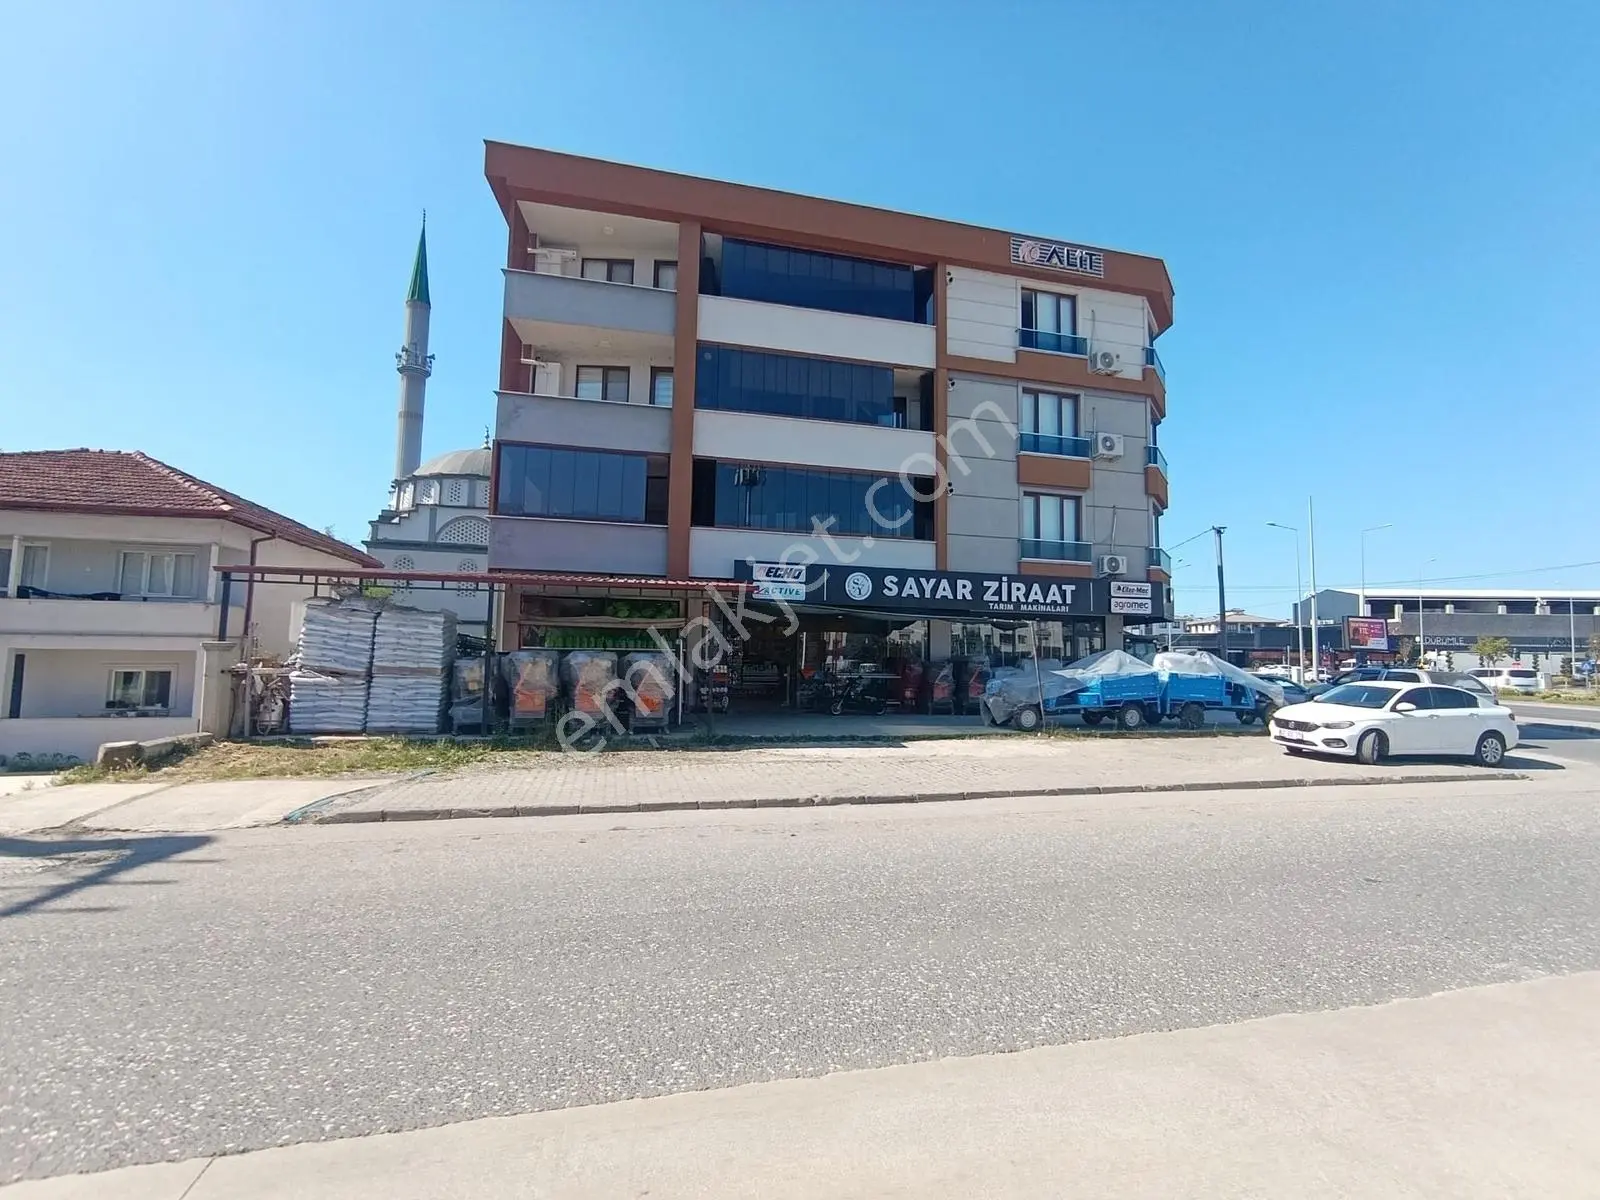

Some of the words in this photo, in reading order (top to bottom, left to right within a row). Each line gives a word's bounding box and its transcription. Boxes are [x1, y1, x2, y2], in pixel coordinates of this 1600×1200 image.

[883, 575, 973, 600] SAYAR
[983, 577, 1076, 604] ZİRAAT
[988, 603, 1014, 611] TARIM
[1020, 604, 1069, 612] MAKİNALARI
[1113, 601, 1149, 610] agromec
